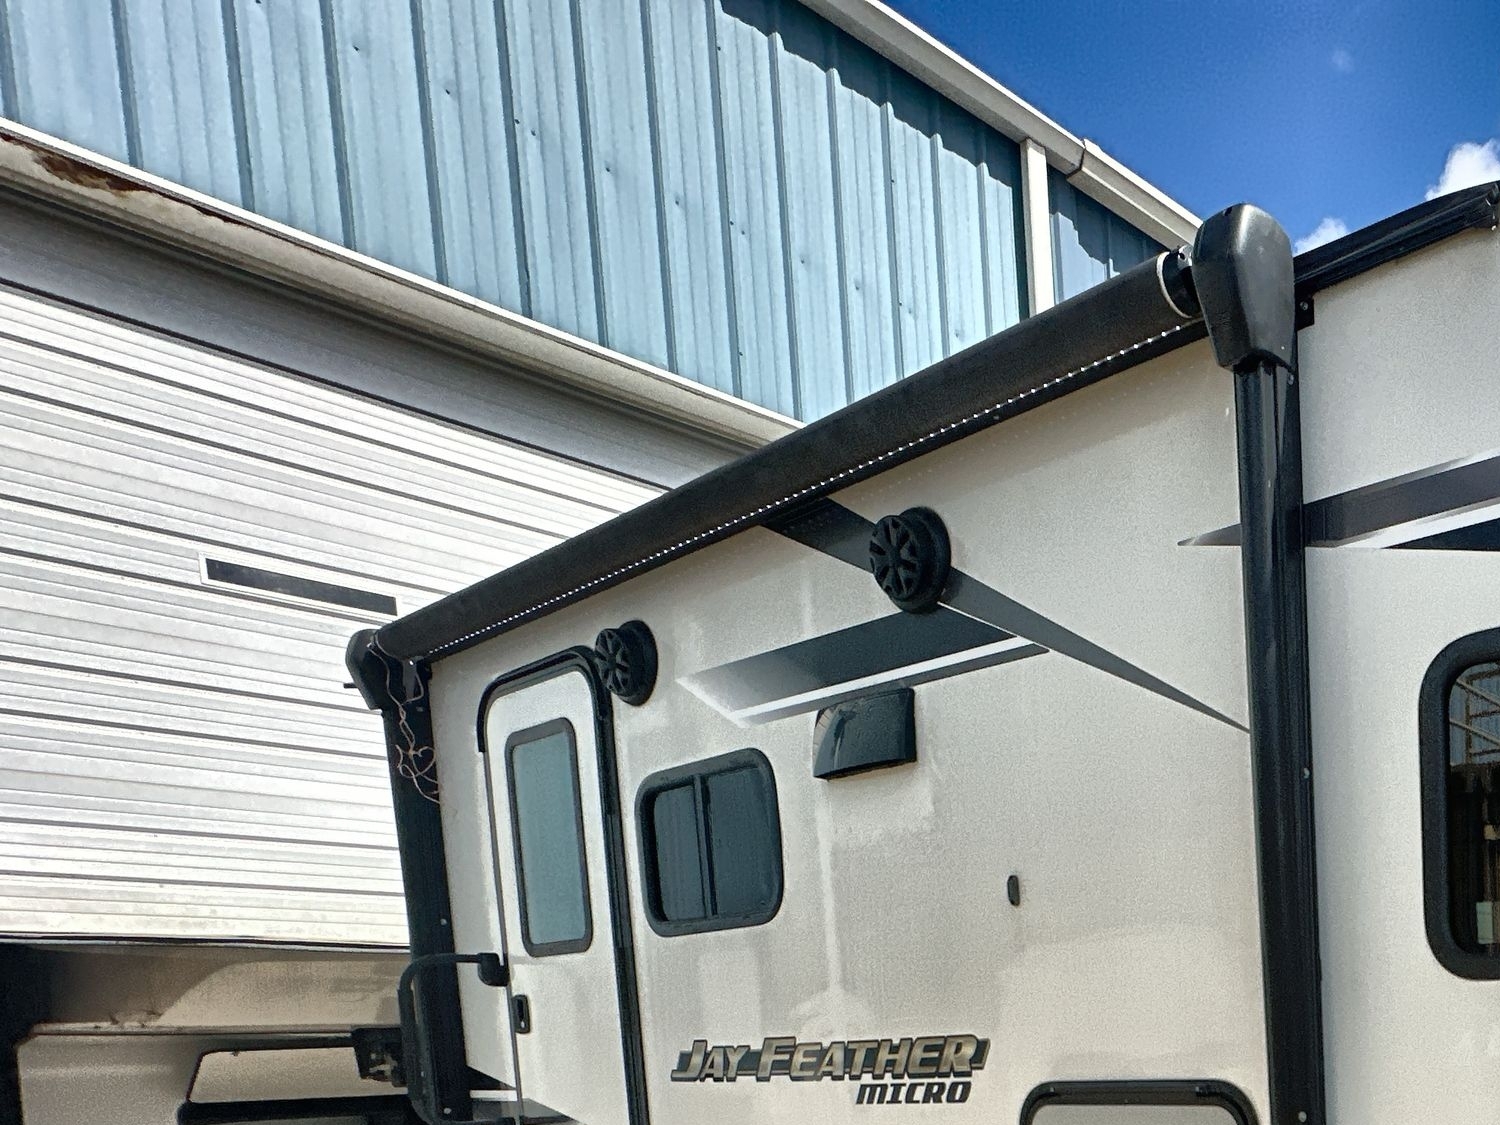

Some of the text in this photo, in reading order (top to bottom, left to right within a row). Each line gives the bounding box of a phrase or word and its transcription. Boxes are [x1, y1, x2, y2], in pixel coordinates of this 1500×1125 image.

[671, 1033, 982, 1082] JAY FEATHER
[855, 1080, 972, 1105] MICRO
